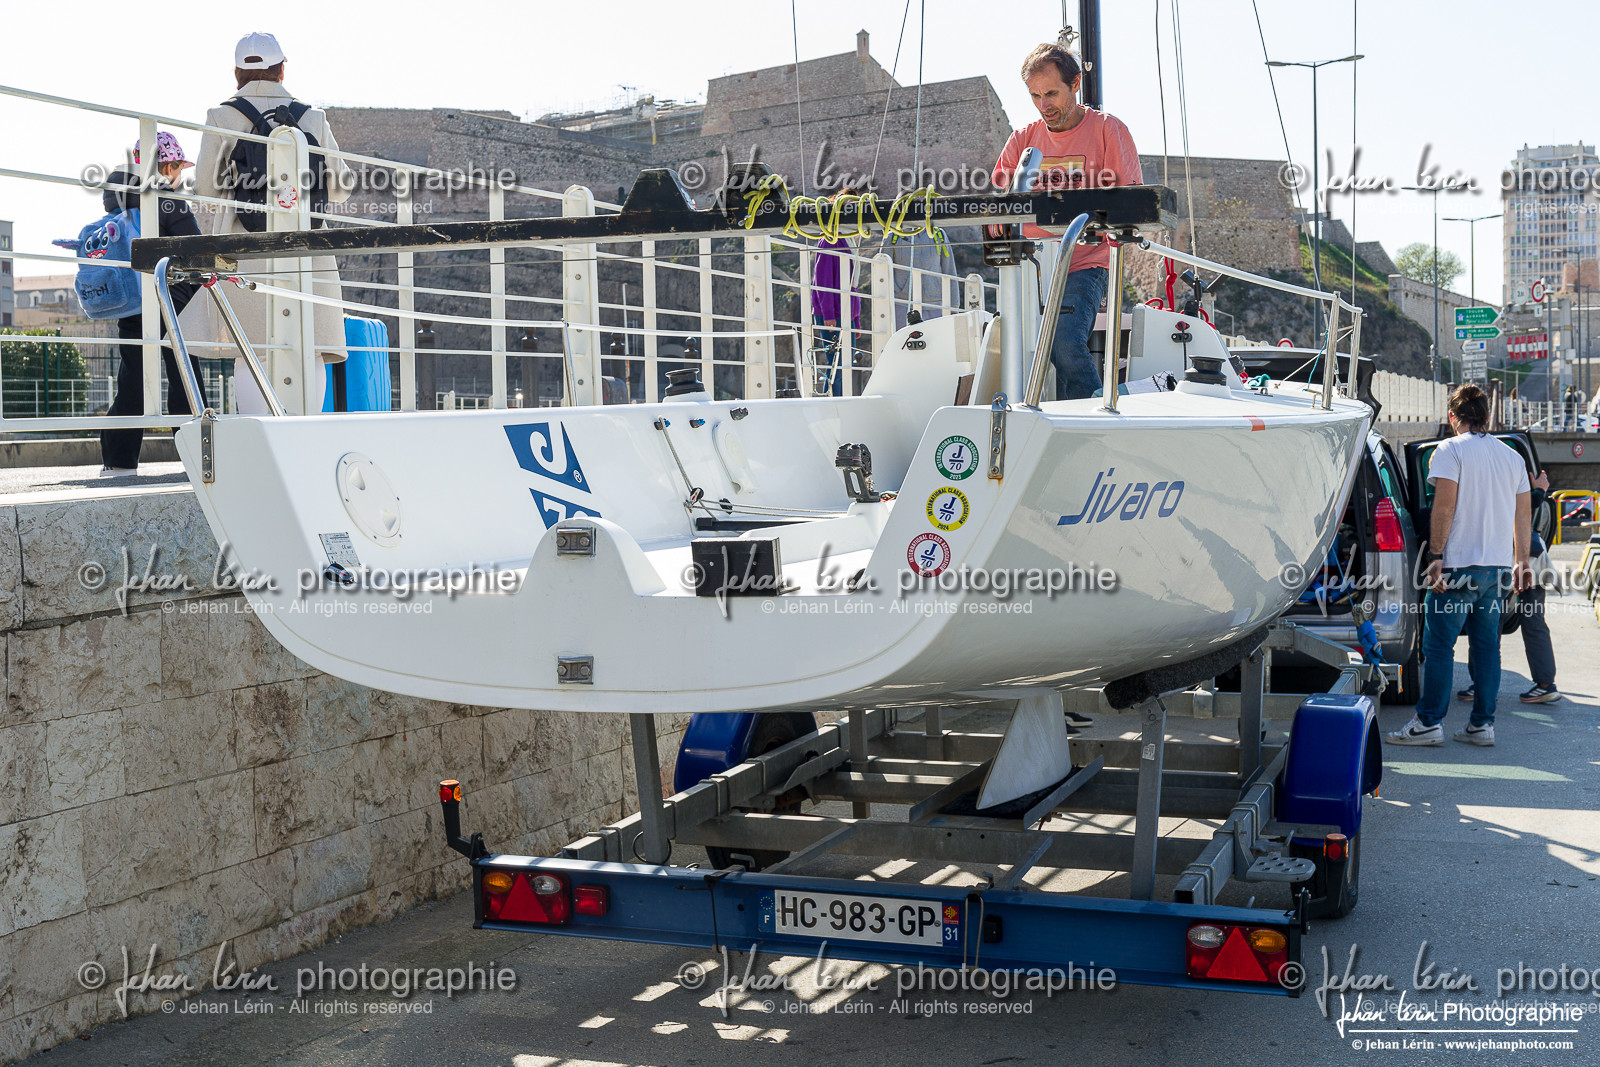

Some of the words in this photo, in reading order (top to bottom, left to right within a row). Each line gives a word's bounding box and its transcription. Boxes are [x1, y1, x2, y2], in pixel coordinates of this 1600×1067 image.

[949, 462, 962, 471] 70
[1057, 467, 1185, 526] Jivaro
[939, 511, 952, 522] 70
[921, 558, 933, 568] 70
[764, 914, 770, 924] F
[780, 895, 936, 937] HC-983-GP
[945, 927, 959, 941] 31
